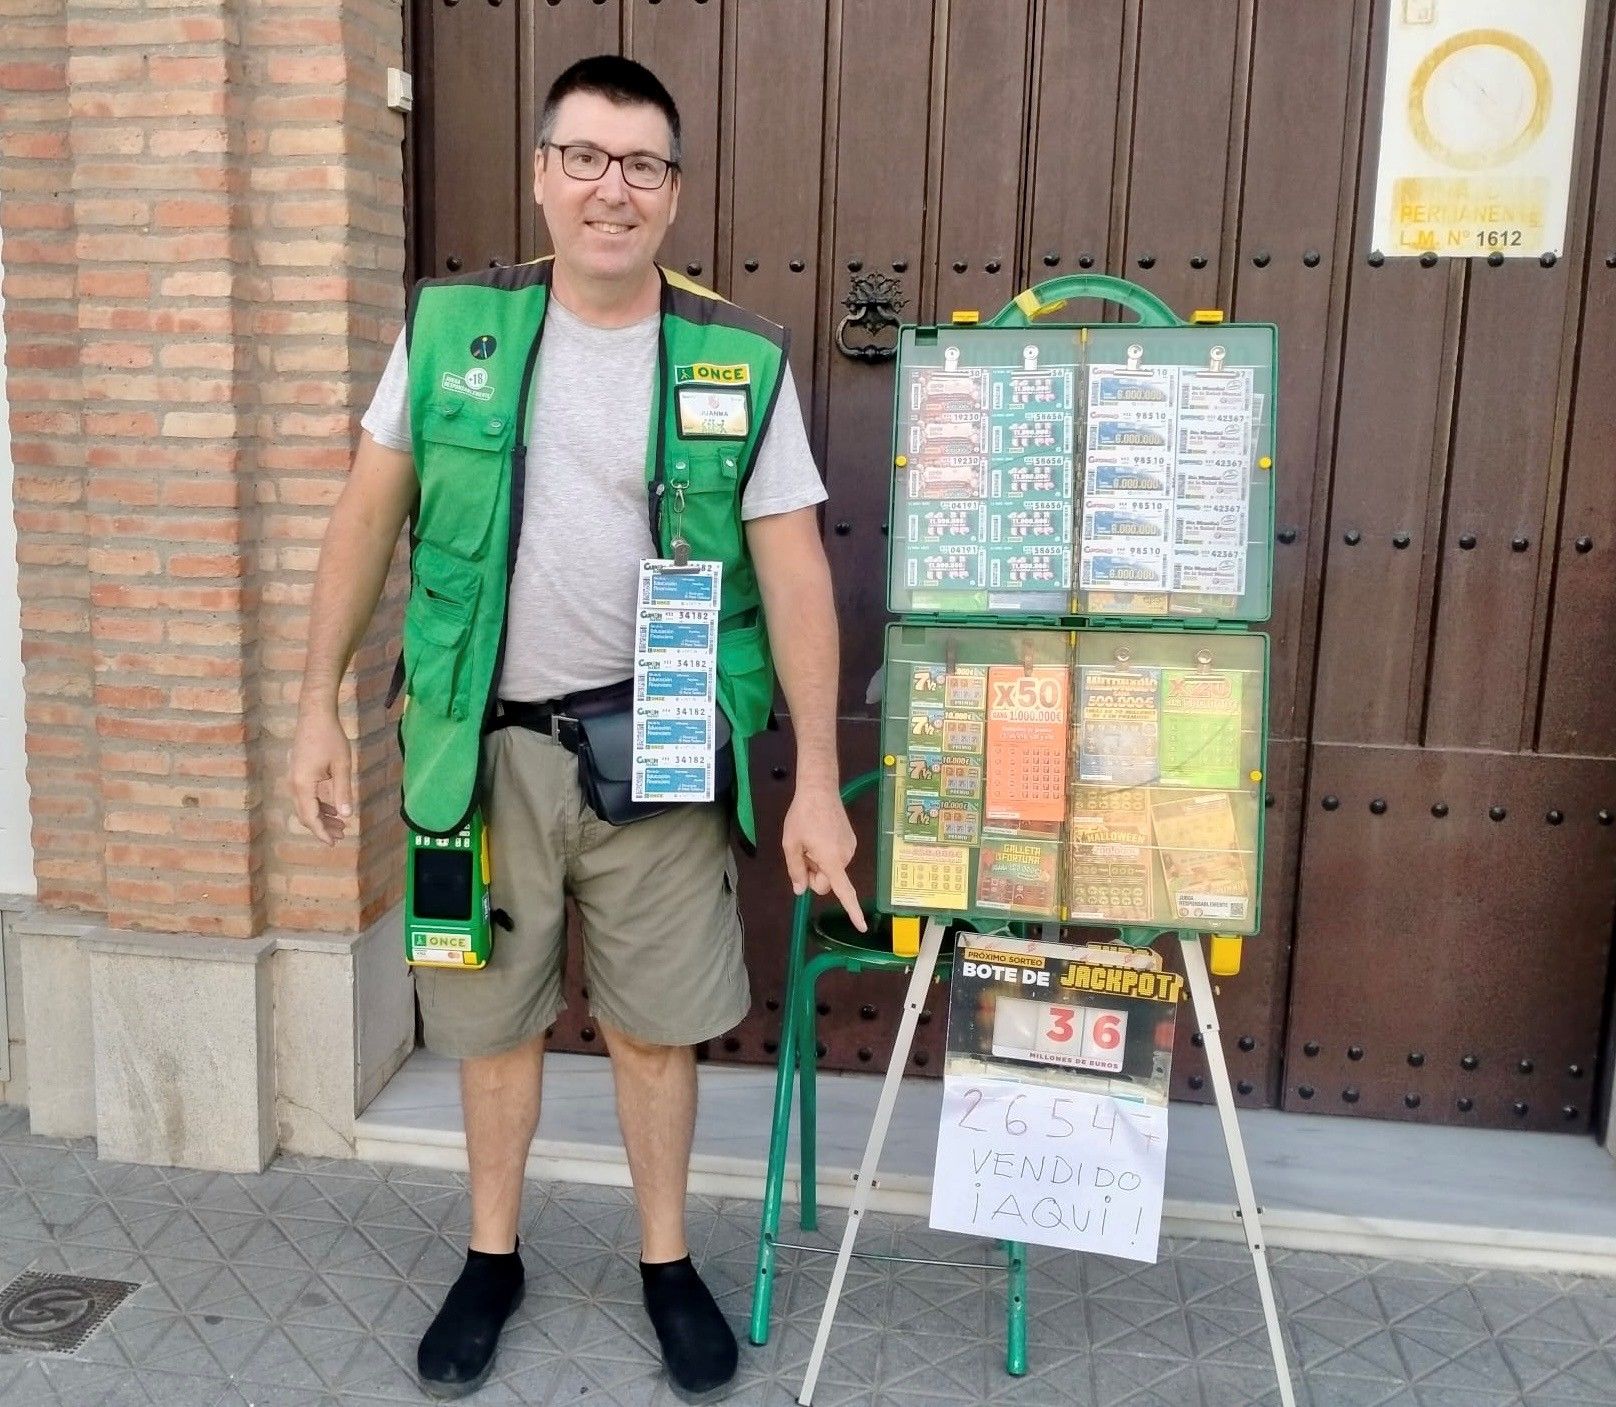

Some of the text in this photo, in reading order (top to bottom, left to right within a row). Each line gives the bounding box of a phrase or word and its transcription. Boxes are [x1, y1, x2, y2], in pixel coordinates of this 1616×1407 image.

[1476, 230, 1523, 246] 1612
[697, 366, 744, 380] ONCE
[679, 611, 708, 620] 34182
[676, 707, 705, 716] 34182
[675, 756, 705, 764] 34182
[1086, 831, 1146, 844] HALLOWEEN
[429, 936, 467, 948] ONCE
[967, 950, 1043, 967] PRÓXIMO SORTEO
[962, 962, 1051, 987] BOTE DE
[1060, 963, 1175, 1001] JACKPOT
[1029, 1052, 1119, 1070] MILLONES DE EUROS
[972, 1149, 1142, 1191] VENDIDO
